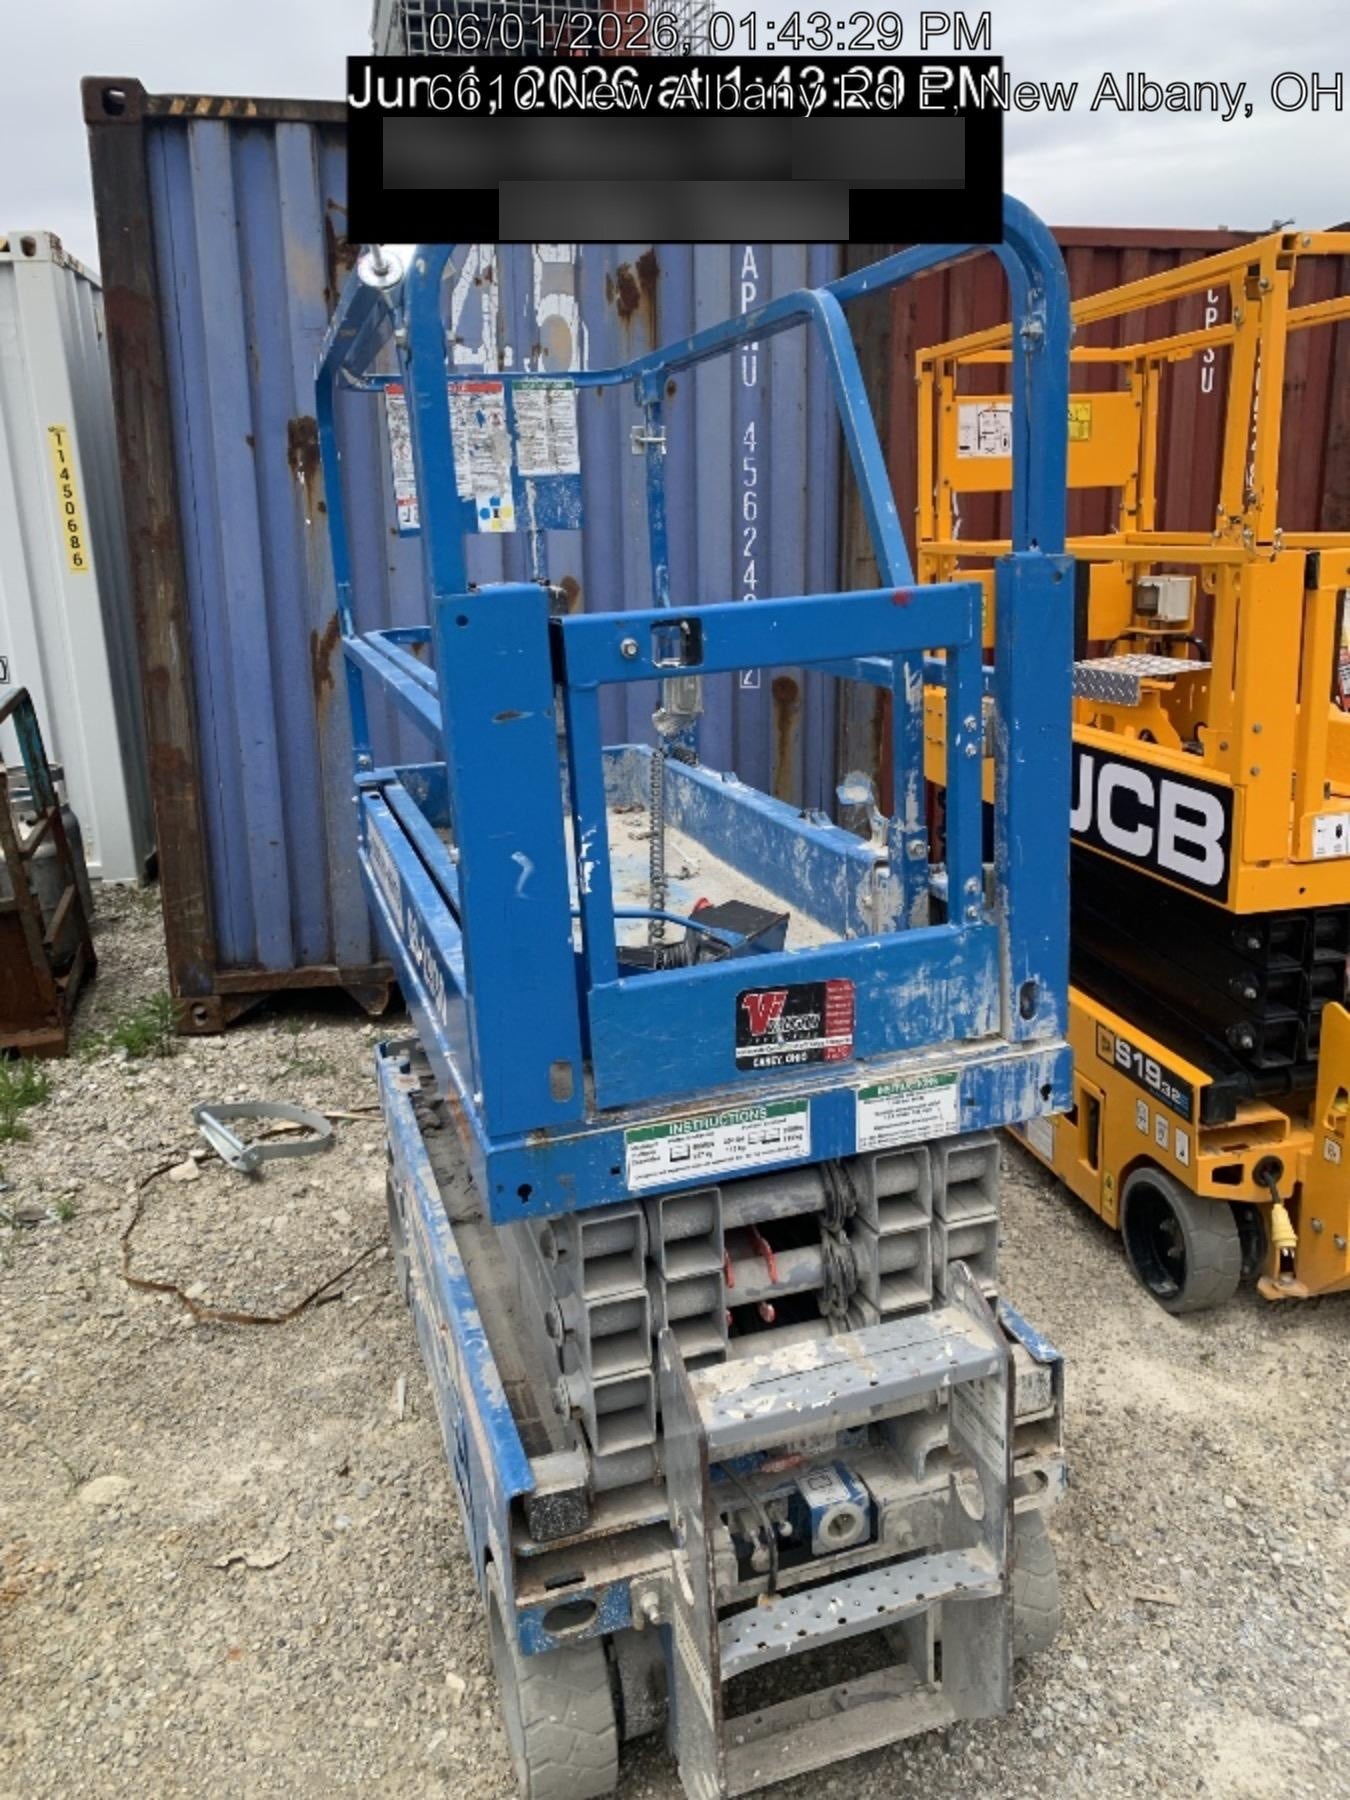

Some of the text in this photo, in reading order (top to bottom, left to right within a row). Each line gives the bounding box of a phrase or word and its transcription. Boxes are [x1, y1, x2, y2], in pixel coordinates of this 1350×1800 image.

[741, 245, 758, 387] APU
[53, 431, 83, 567] 11450686
[743, 421, 758, 602] 45624
[1071, 753, 1226, 887] JCB
[668, 1105, 768, 1135] INSTRUCTIONS
